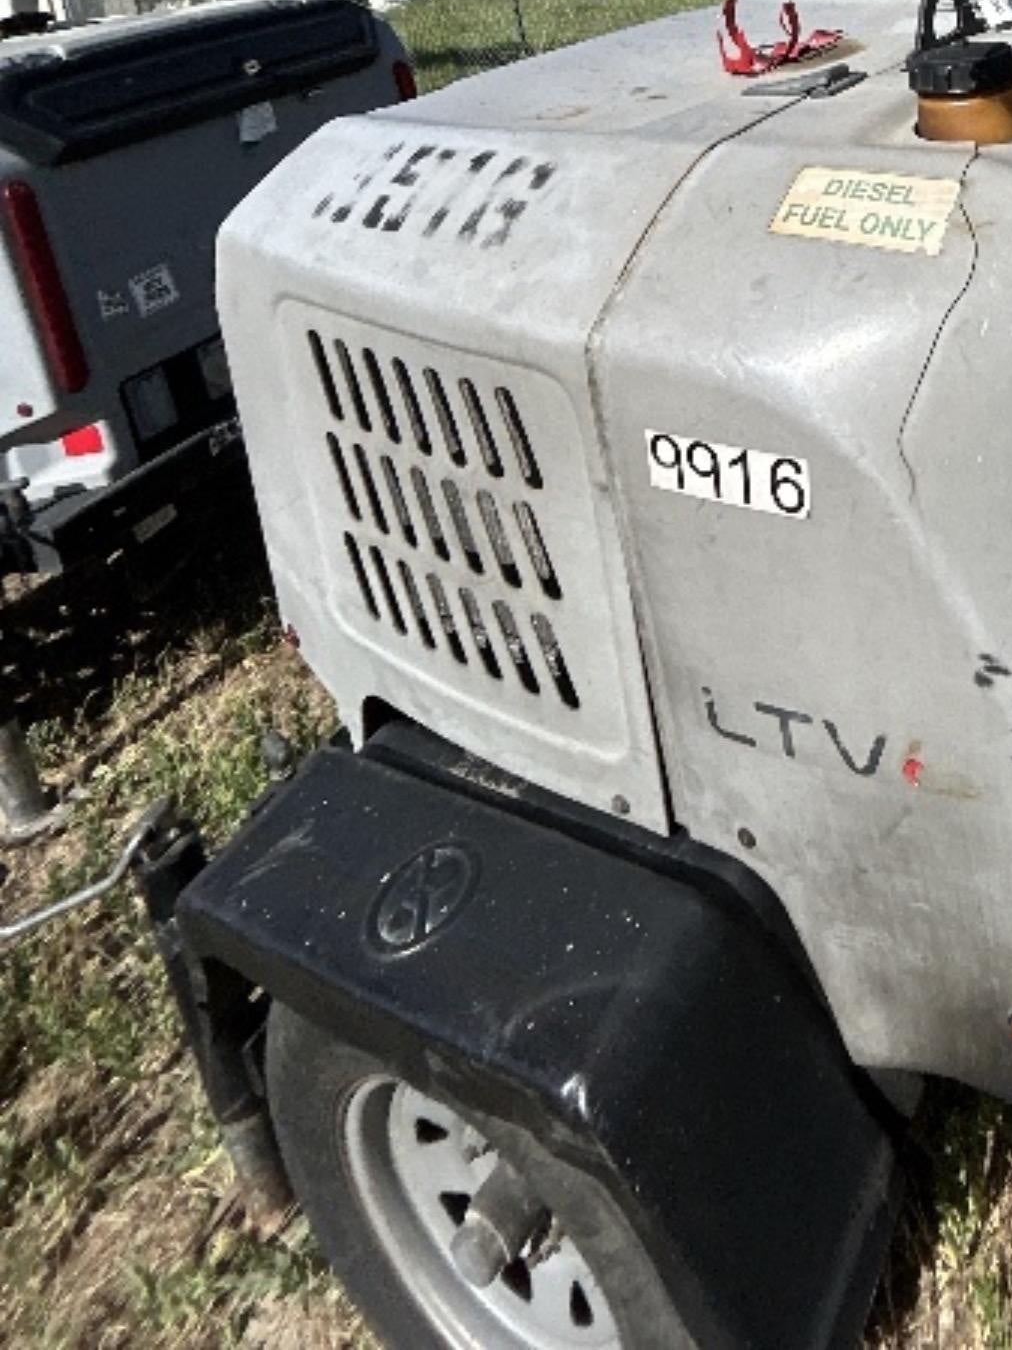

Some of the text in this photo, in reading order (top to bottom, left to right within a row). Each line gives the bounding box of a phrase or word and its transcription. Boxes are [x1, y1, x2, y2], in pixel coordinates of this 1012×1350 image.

[822, 178, 915, 205] DIESEL
[782, 203, 937, 242] FUEL ONLY
[650, 434, 805, 514] 9916
[701, 686, 886, 777] LTV
